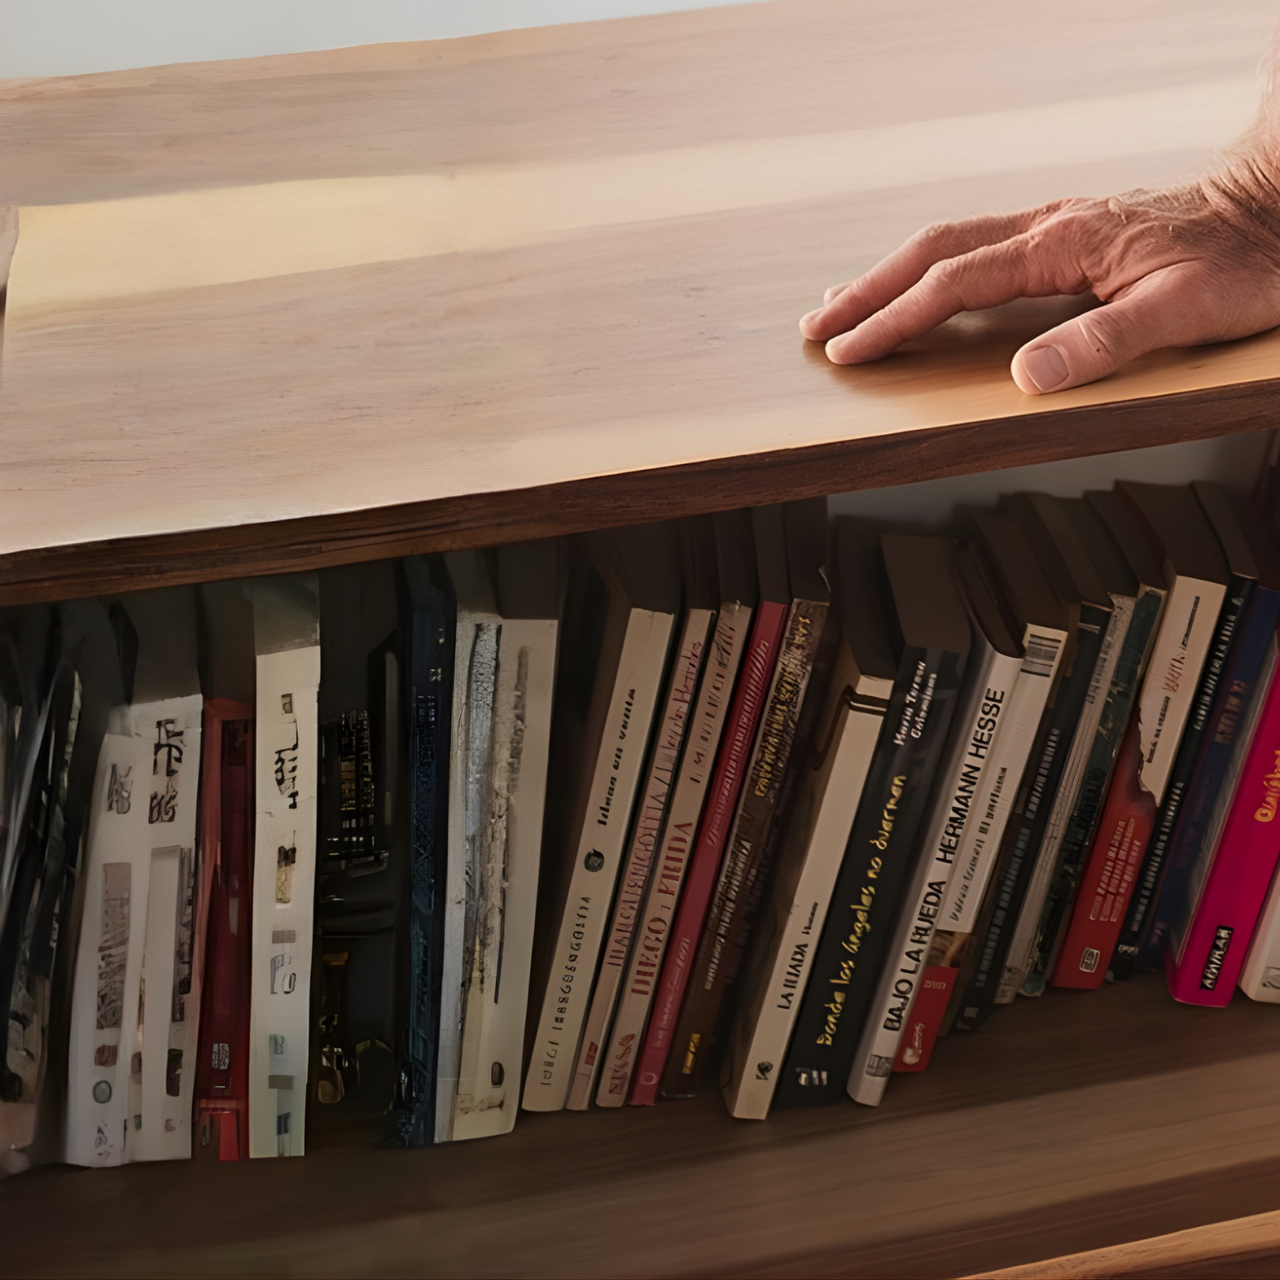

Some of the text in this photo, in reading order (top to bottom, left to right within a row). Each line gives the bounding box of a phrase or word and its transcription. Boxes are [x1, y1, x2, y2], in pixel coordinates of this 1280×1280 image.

[967, 687, 1005, 760] HESSE
[934, 761, 981, 866] HERMANN
[909, 880, 947, 945] RUEDA
[900, 948, 924, 975] LA
[880, 974, 914, 1033] BAJO
